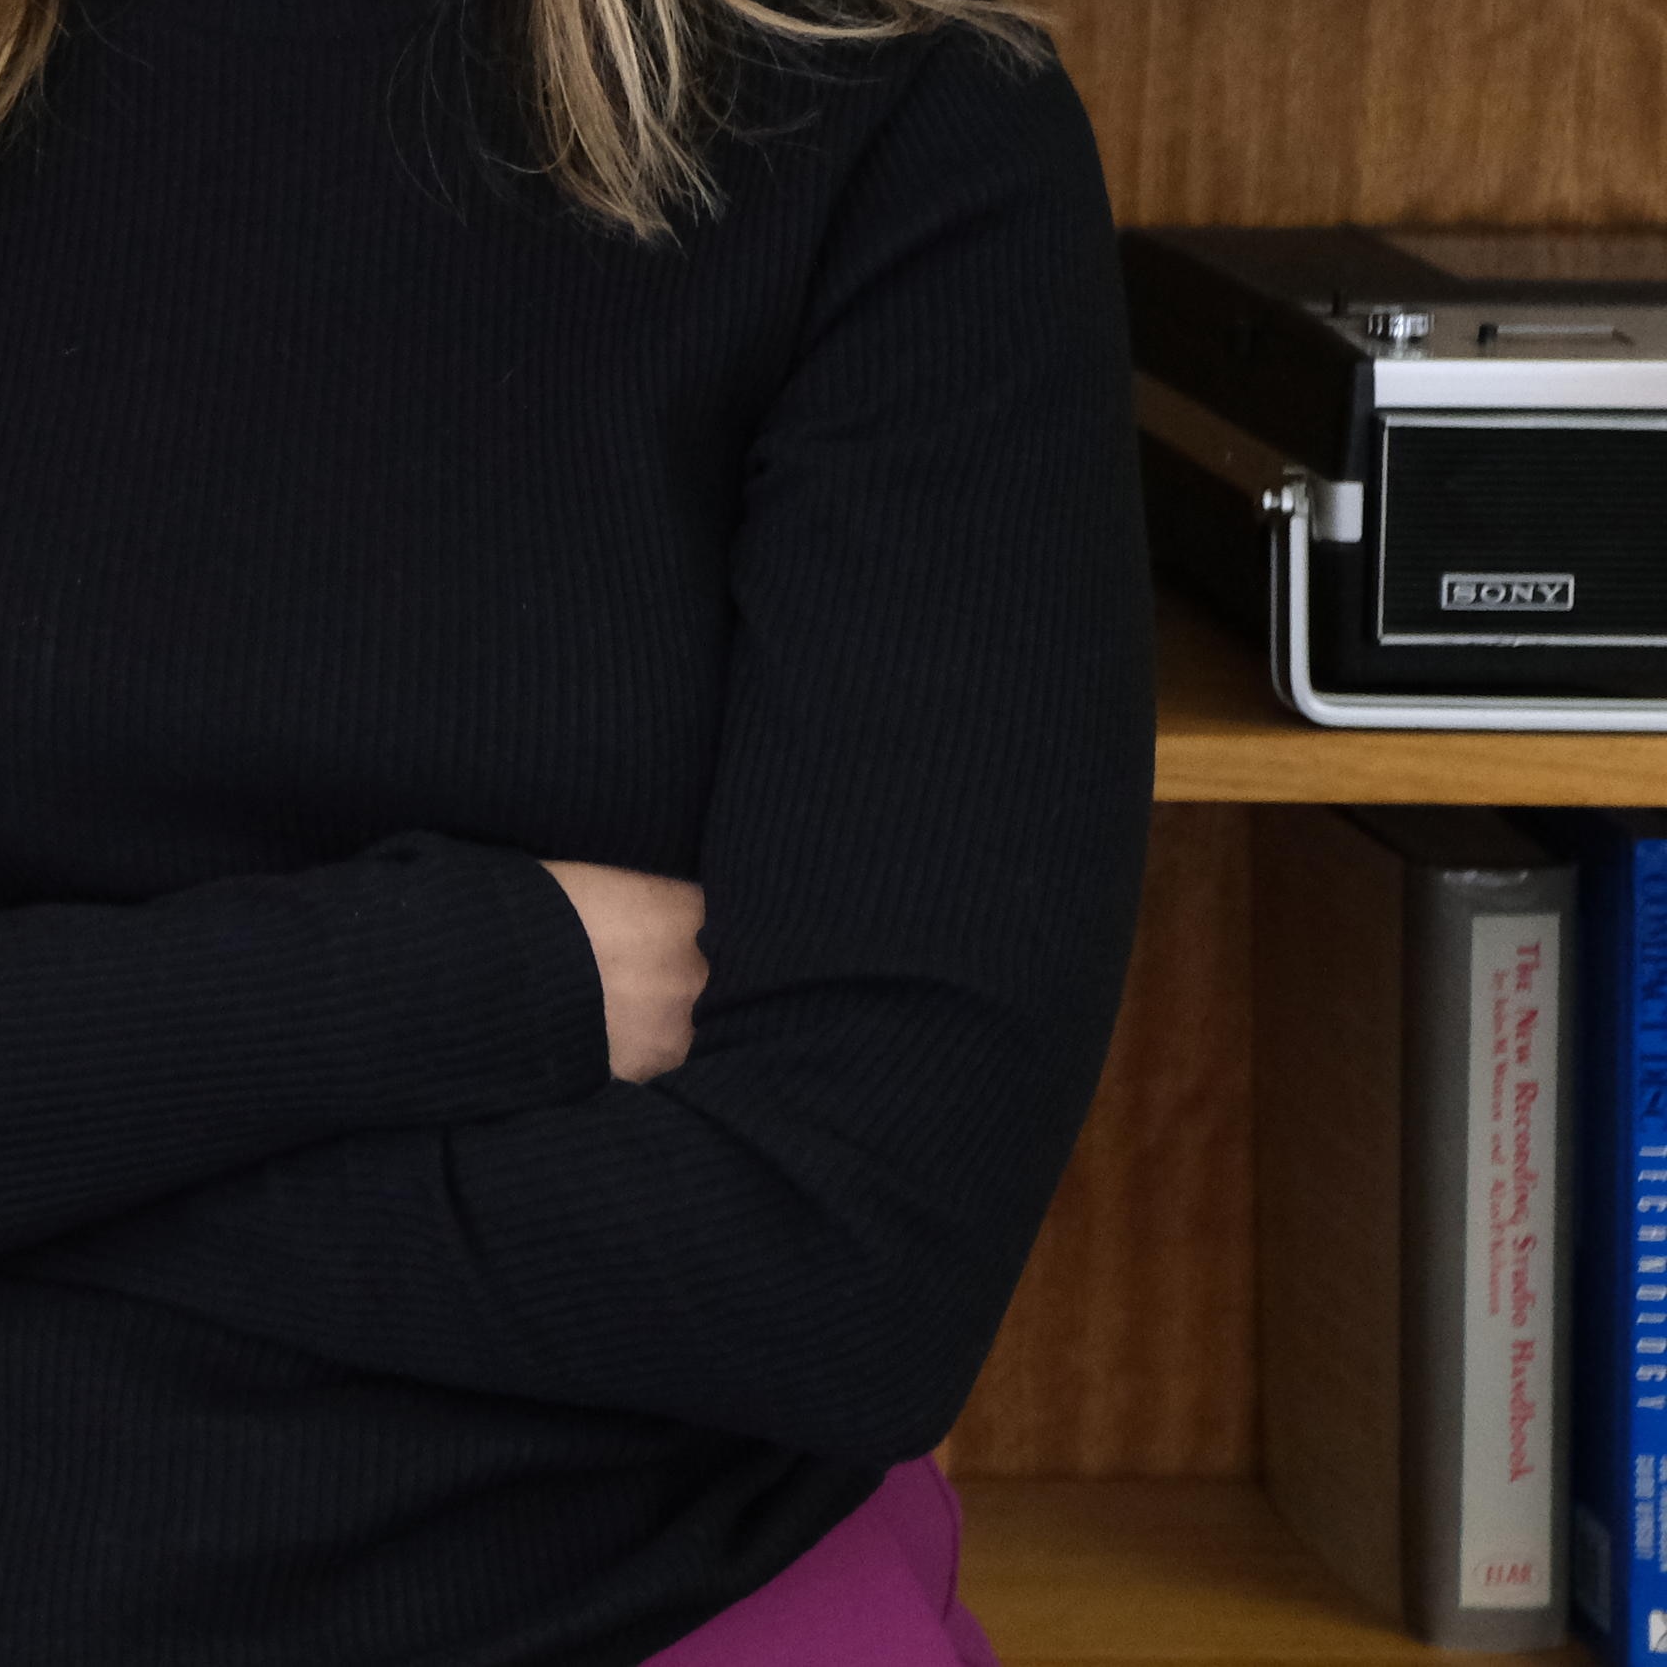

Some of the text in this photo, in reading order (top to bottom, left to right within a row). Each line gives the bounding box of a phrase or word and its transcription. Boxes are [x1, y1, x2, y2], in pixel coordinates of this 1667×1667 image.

[1453, 584, 1563, 604] SONY
[1515, 942, 1541, 990] The
[1515, 1009, 1539, 1064] New
[1495, 1081, 1540, 1231] Recording
[1513, 1234, 1537, 1327] Studio
[1509, 1339, 1536, 1484] Handbook
